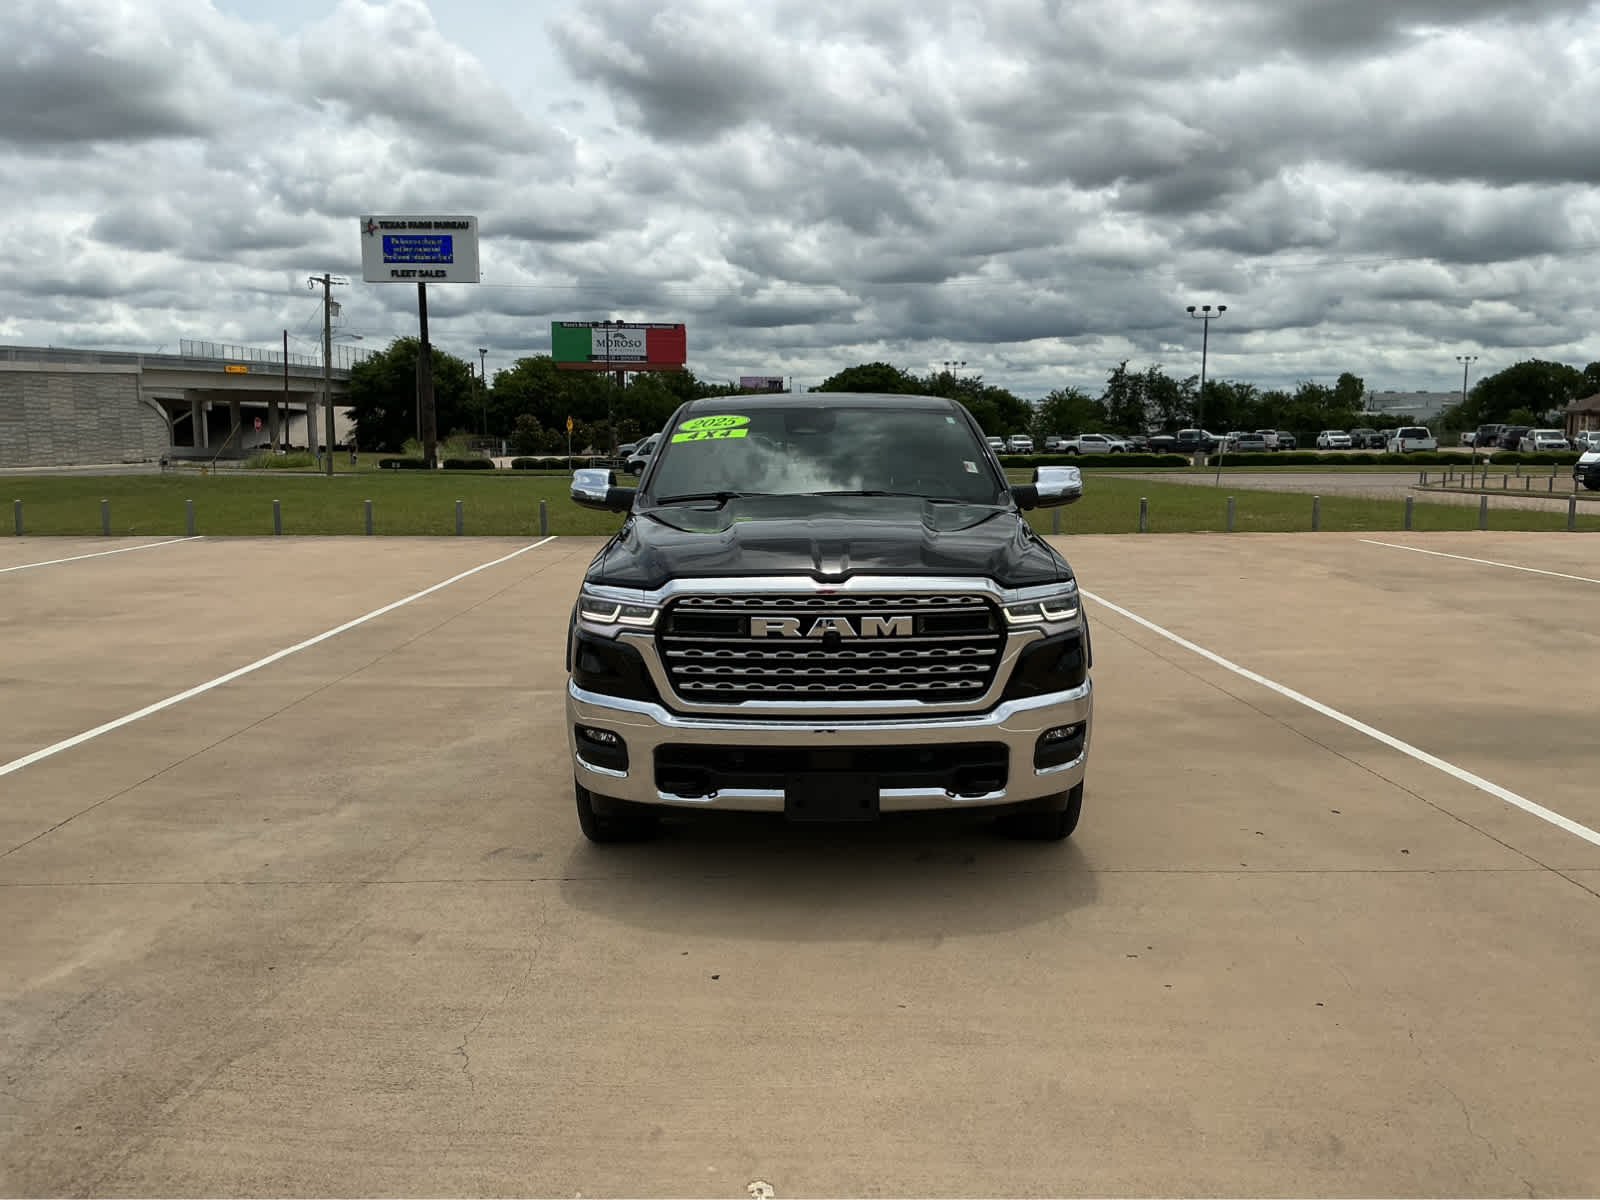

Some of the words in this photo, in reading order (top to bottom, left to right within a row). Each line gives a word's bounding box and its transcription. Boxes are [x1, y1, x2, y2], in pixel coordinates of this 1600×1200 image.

[378, 221, 406, 230] TEXAS
[407, 221, 432, 230] FARM
[433, 221, 469, 230] BUREAU
[391, 269, 417, 278] FLEET
[418, 269, 446, 278] SALES
[596, 339, 642, 348] MOROSO
[690, 417, 735, 429] 2025
[751, 616, 913, 637] RAM
